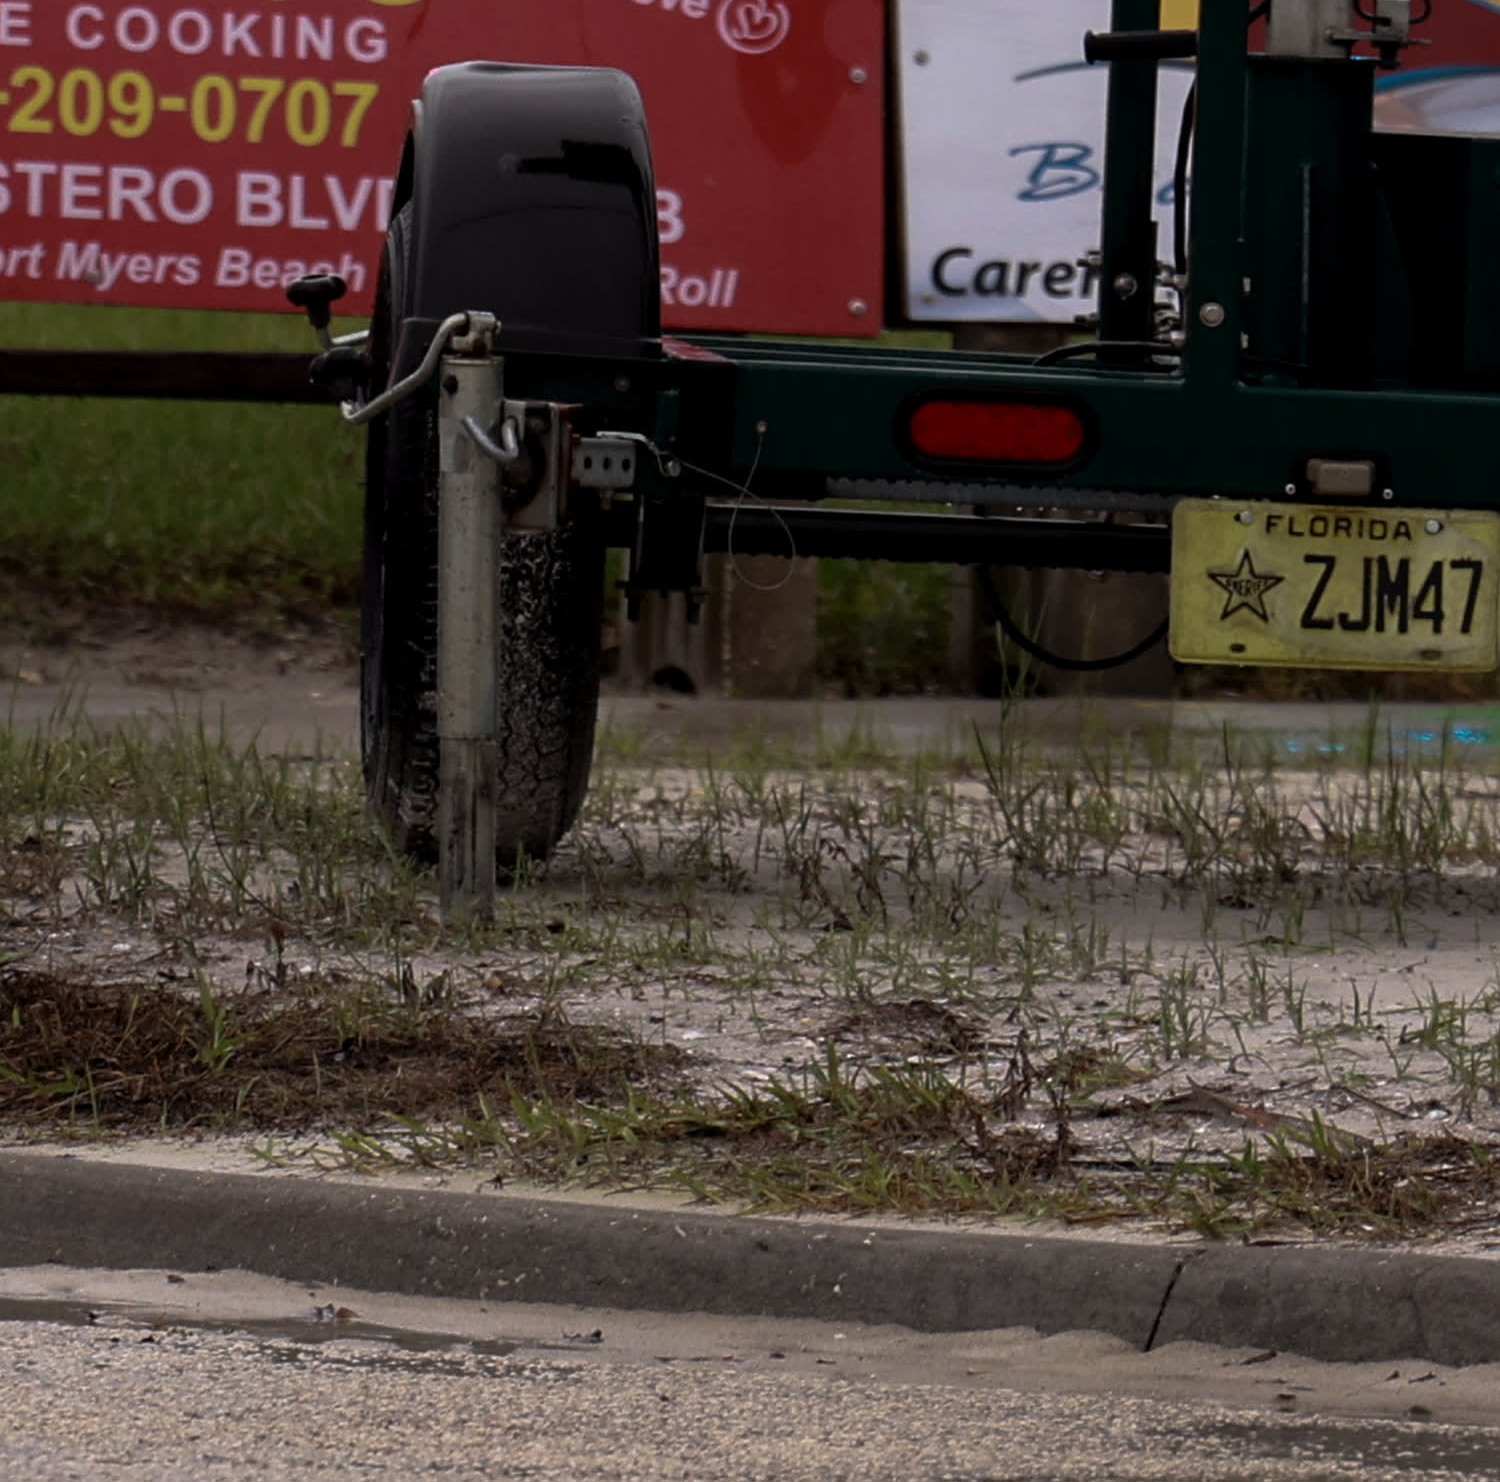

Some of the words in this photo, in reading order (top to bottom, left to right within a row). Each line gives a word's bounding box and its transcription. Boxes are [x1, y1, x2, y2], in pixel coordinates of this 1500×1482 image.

[66, 3, 389, 65] COOKING
[57, 242, 199, 292] Myers
[1265, 513, 1413, 542] FLORIDA
[1300, 553, 1484, 635] ZJM47
